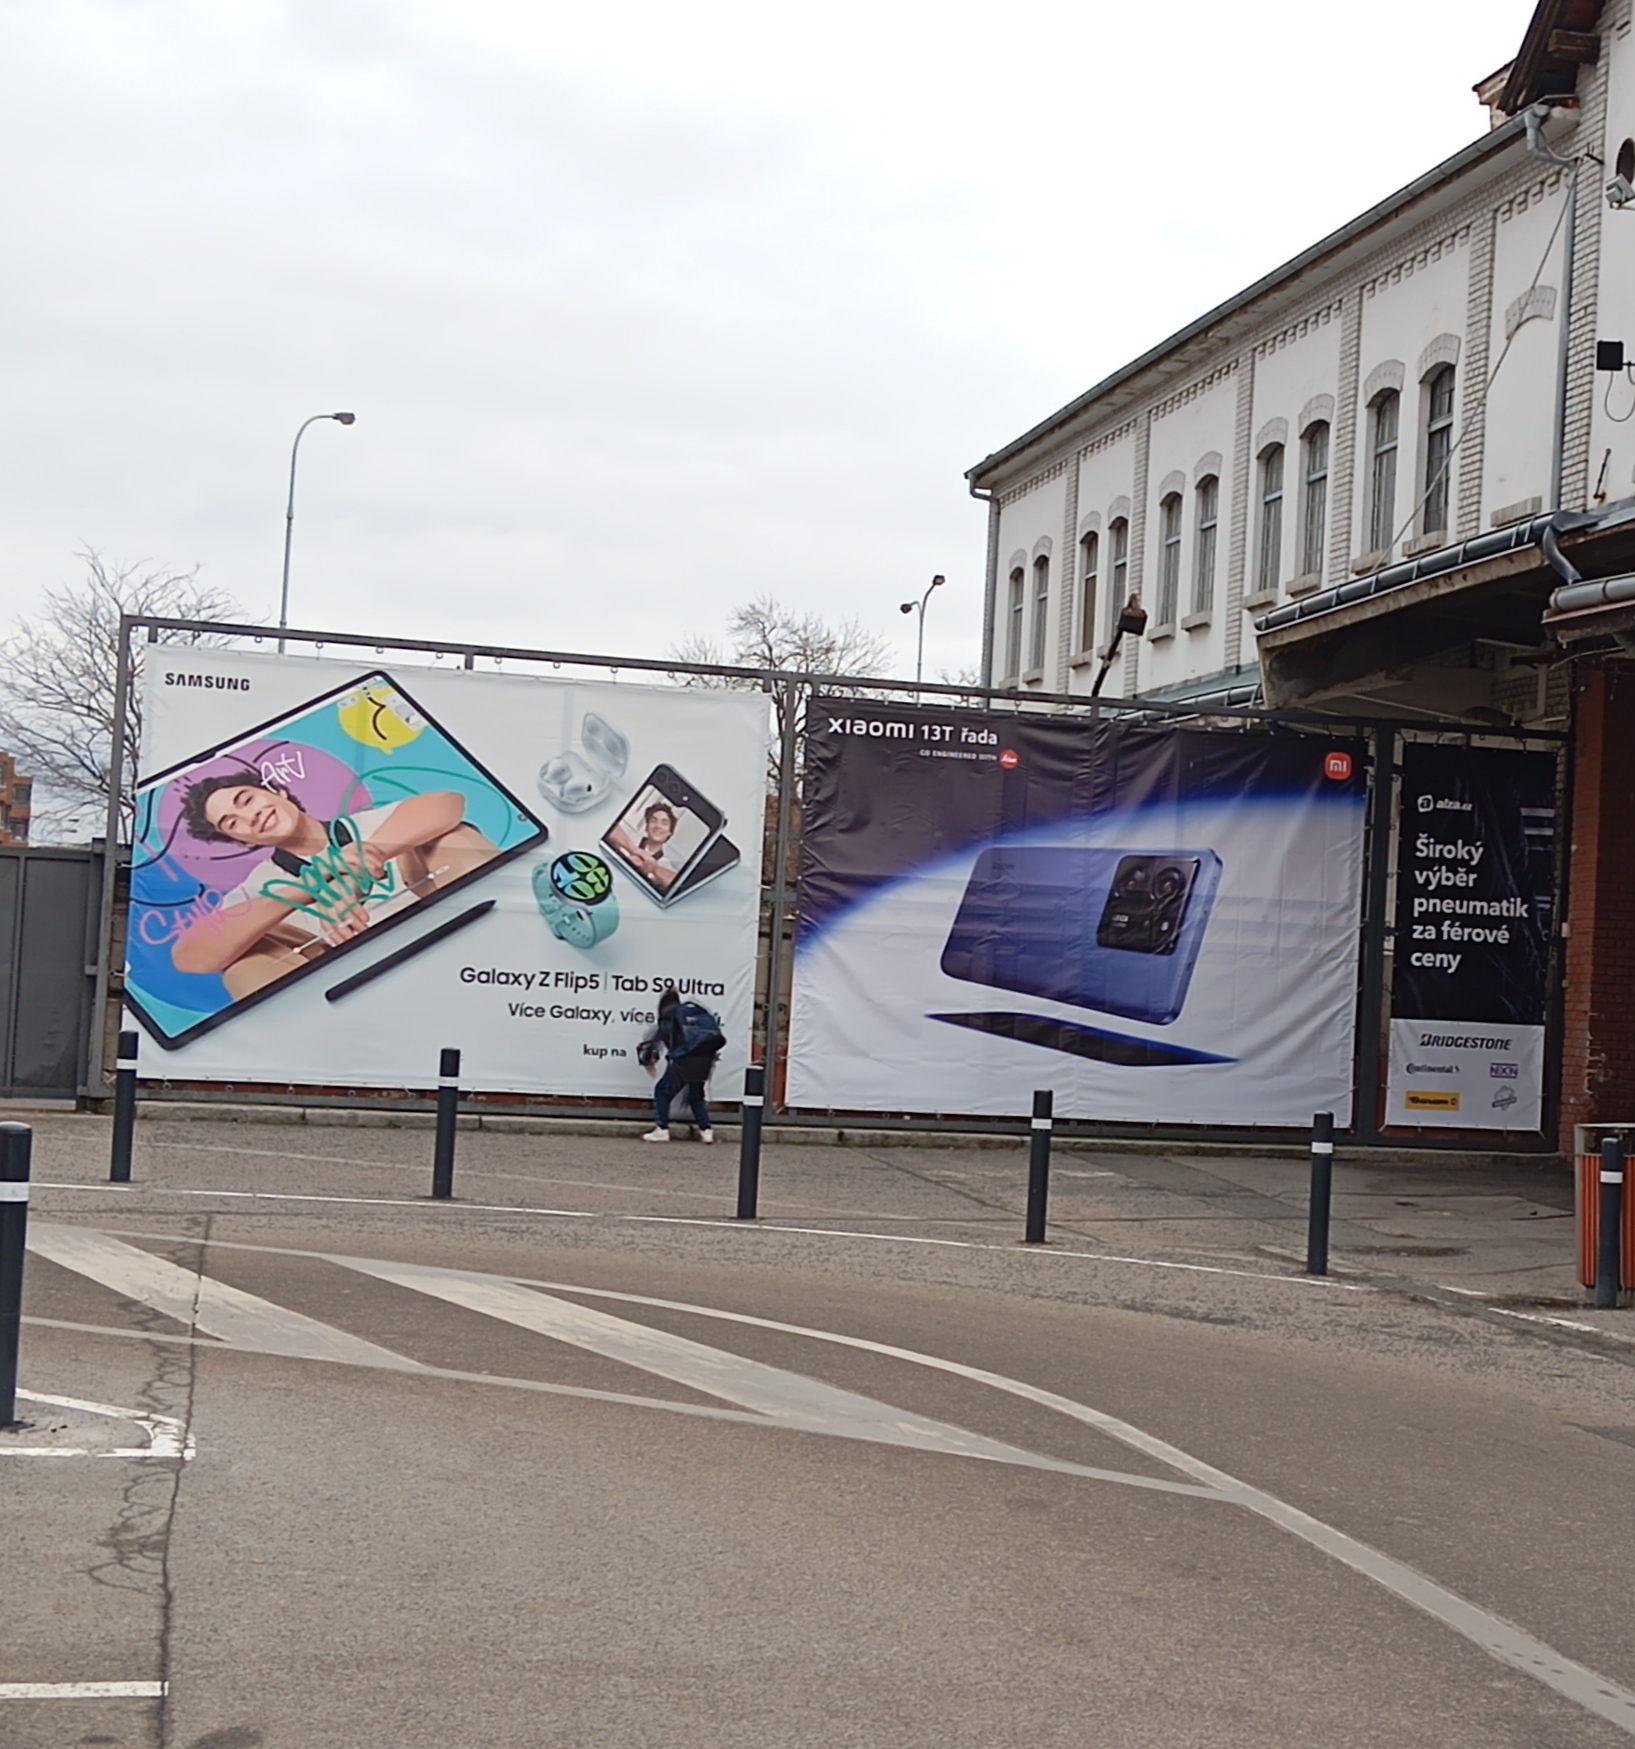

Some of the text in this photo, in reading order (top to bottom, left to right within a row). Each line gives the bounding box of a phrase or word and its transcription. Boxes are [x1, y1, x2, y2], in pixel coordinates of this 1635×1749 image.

[165, 672, 250, 691] SAMSUNG
[921, 725, 954, 742] 13T
[961, 727, 998, 745] řada
[1415, 833, 1484, 866] Široký
[1414, 865, 1478, 890] výběr
[1413, 897, 1529, 918] pneumatik
[1412, 920, 1510, 944] za férové
[1410, 952, 1462, 974] ceny
[460, 967, 536, 991] Galaxy
[538, 971, 550, 988] Z
[554, 971, 600, 993] Flip5
[612, 974, 648, 993] Tab
[679, 979, 725, 996] Ultra
[508, 1002, 545, 1019] Více
[620, 1008, 655, 1023] více
[583, 1044, 627, 1059] kup na
[1419, 1033, 1513, 1051] BRIDGESTONE
